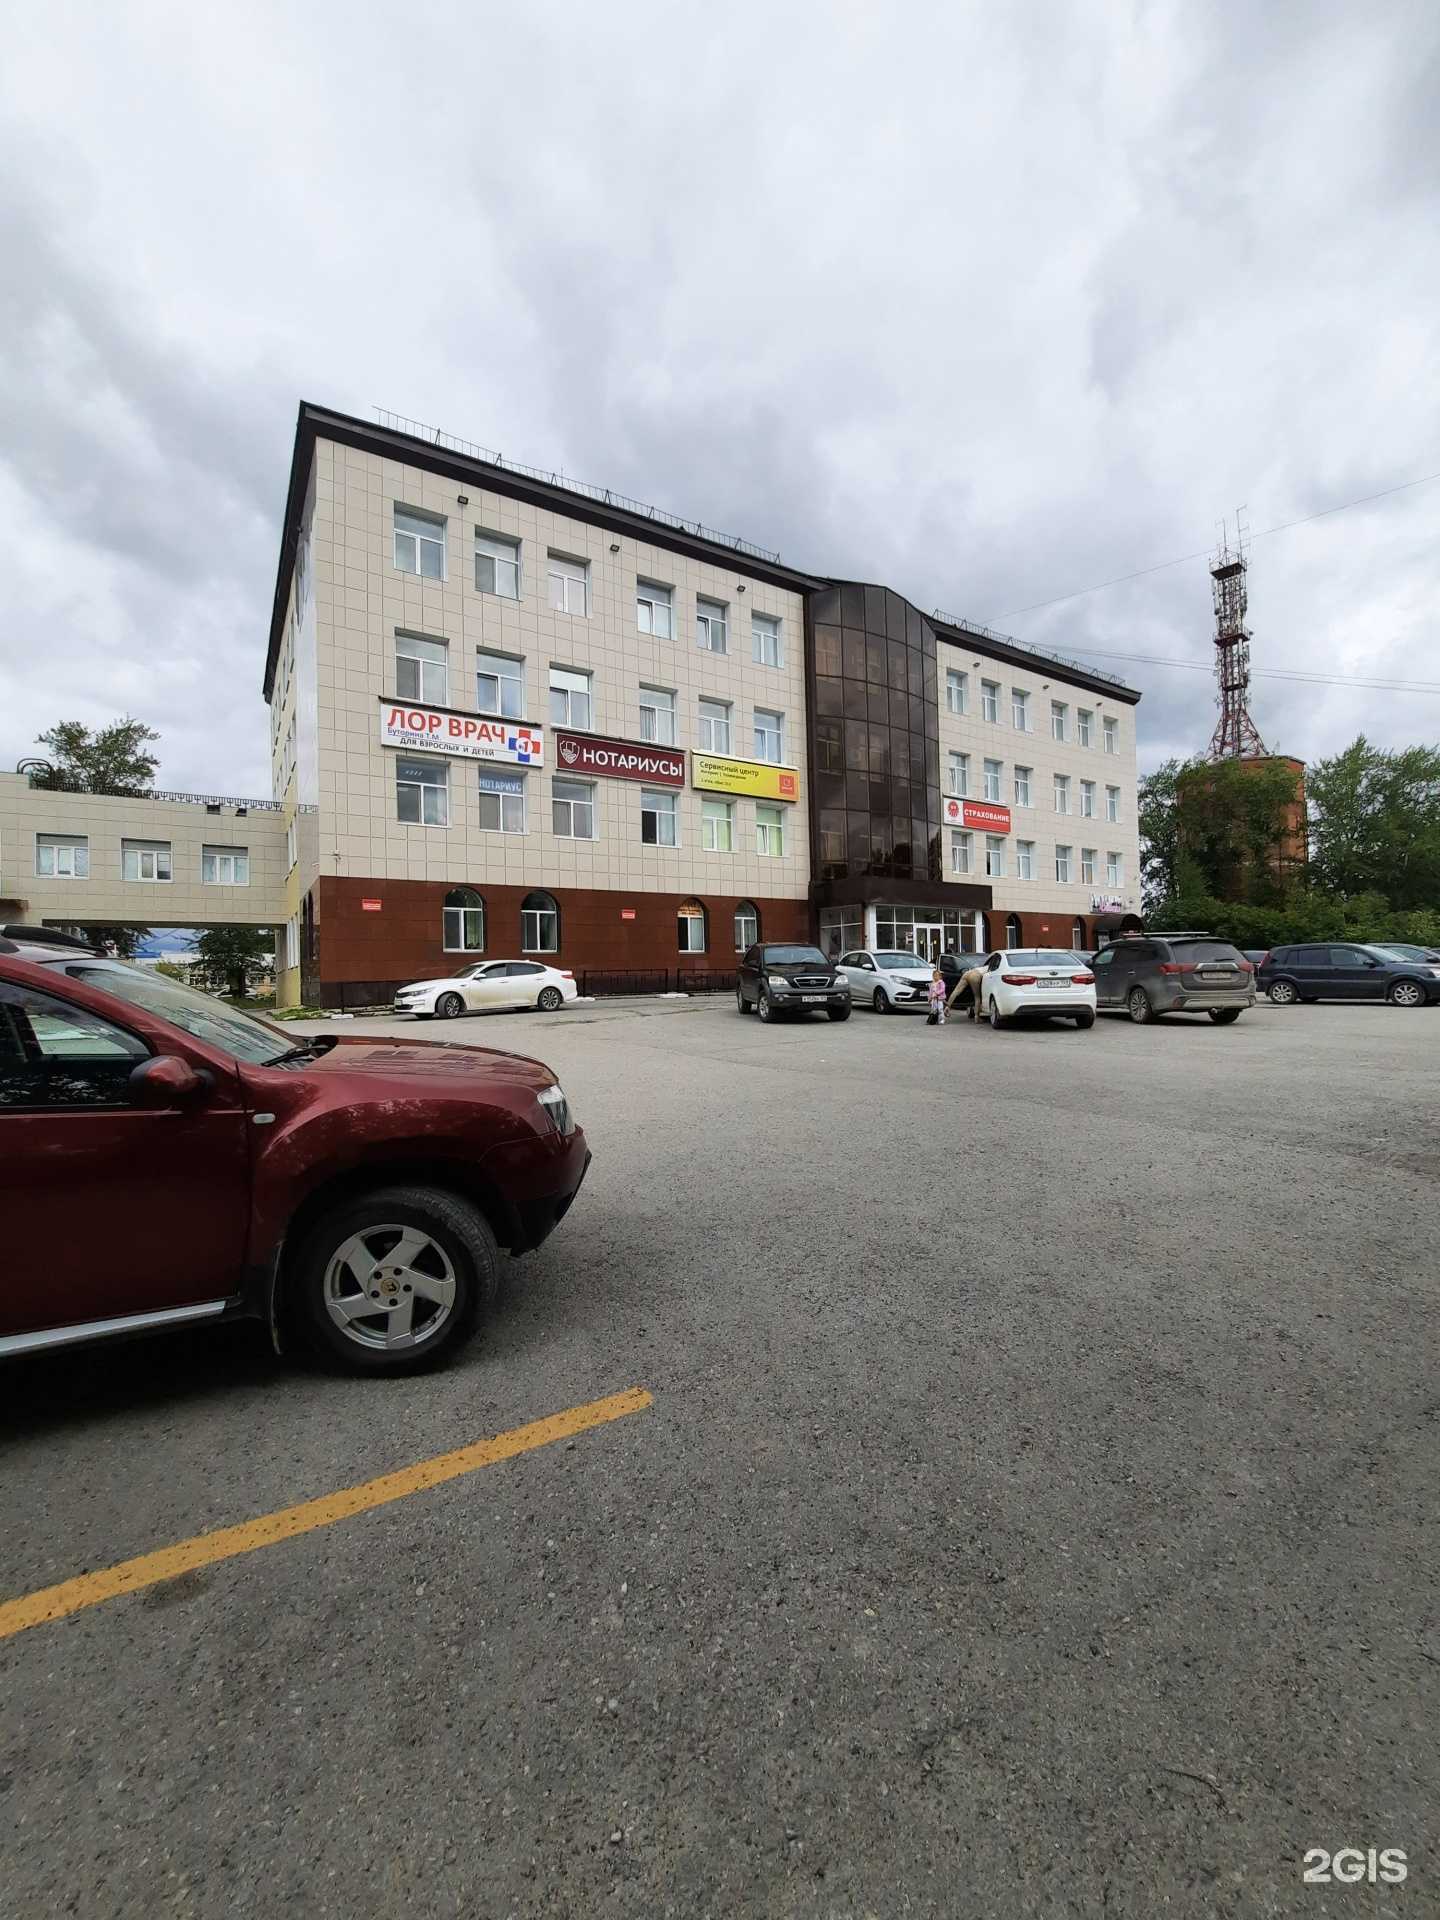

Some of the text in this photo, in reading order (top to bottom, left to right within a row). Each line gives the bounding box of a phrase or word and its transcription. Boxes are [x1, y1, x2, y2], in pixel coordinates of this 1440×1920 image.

[387, 708, 506, 744] ЛОР ВРАЧ
[387, 727, 424, 739] Буторина
[400, 737, 417, 746] ДЛЯ
[419, 740, 460, 752] ВЗРОСЛЫХ
[471, 747, 495, 757] ДЕТЕЙ
[583, 748, 683, 777] НОТАРИУСЫ
[700, 761, 739, 774] Сервисный
[739, 768, 760, 777] центр
[479, 778, 522, 792] НОТАРИУС
[964, 808, 1010, 823] СТРАХОВАНИЕ
